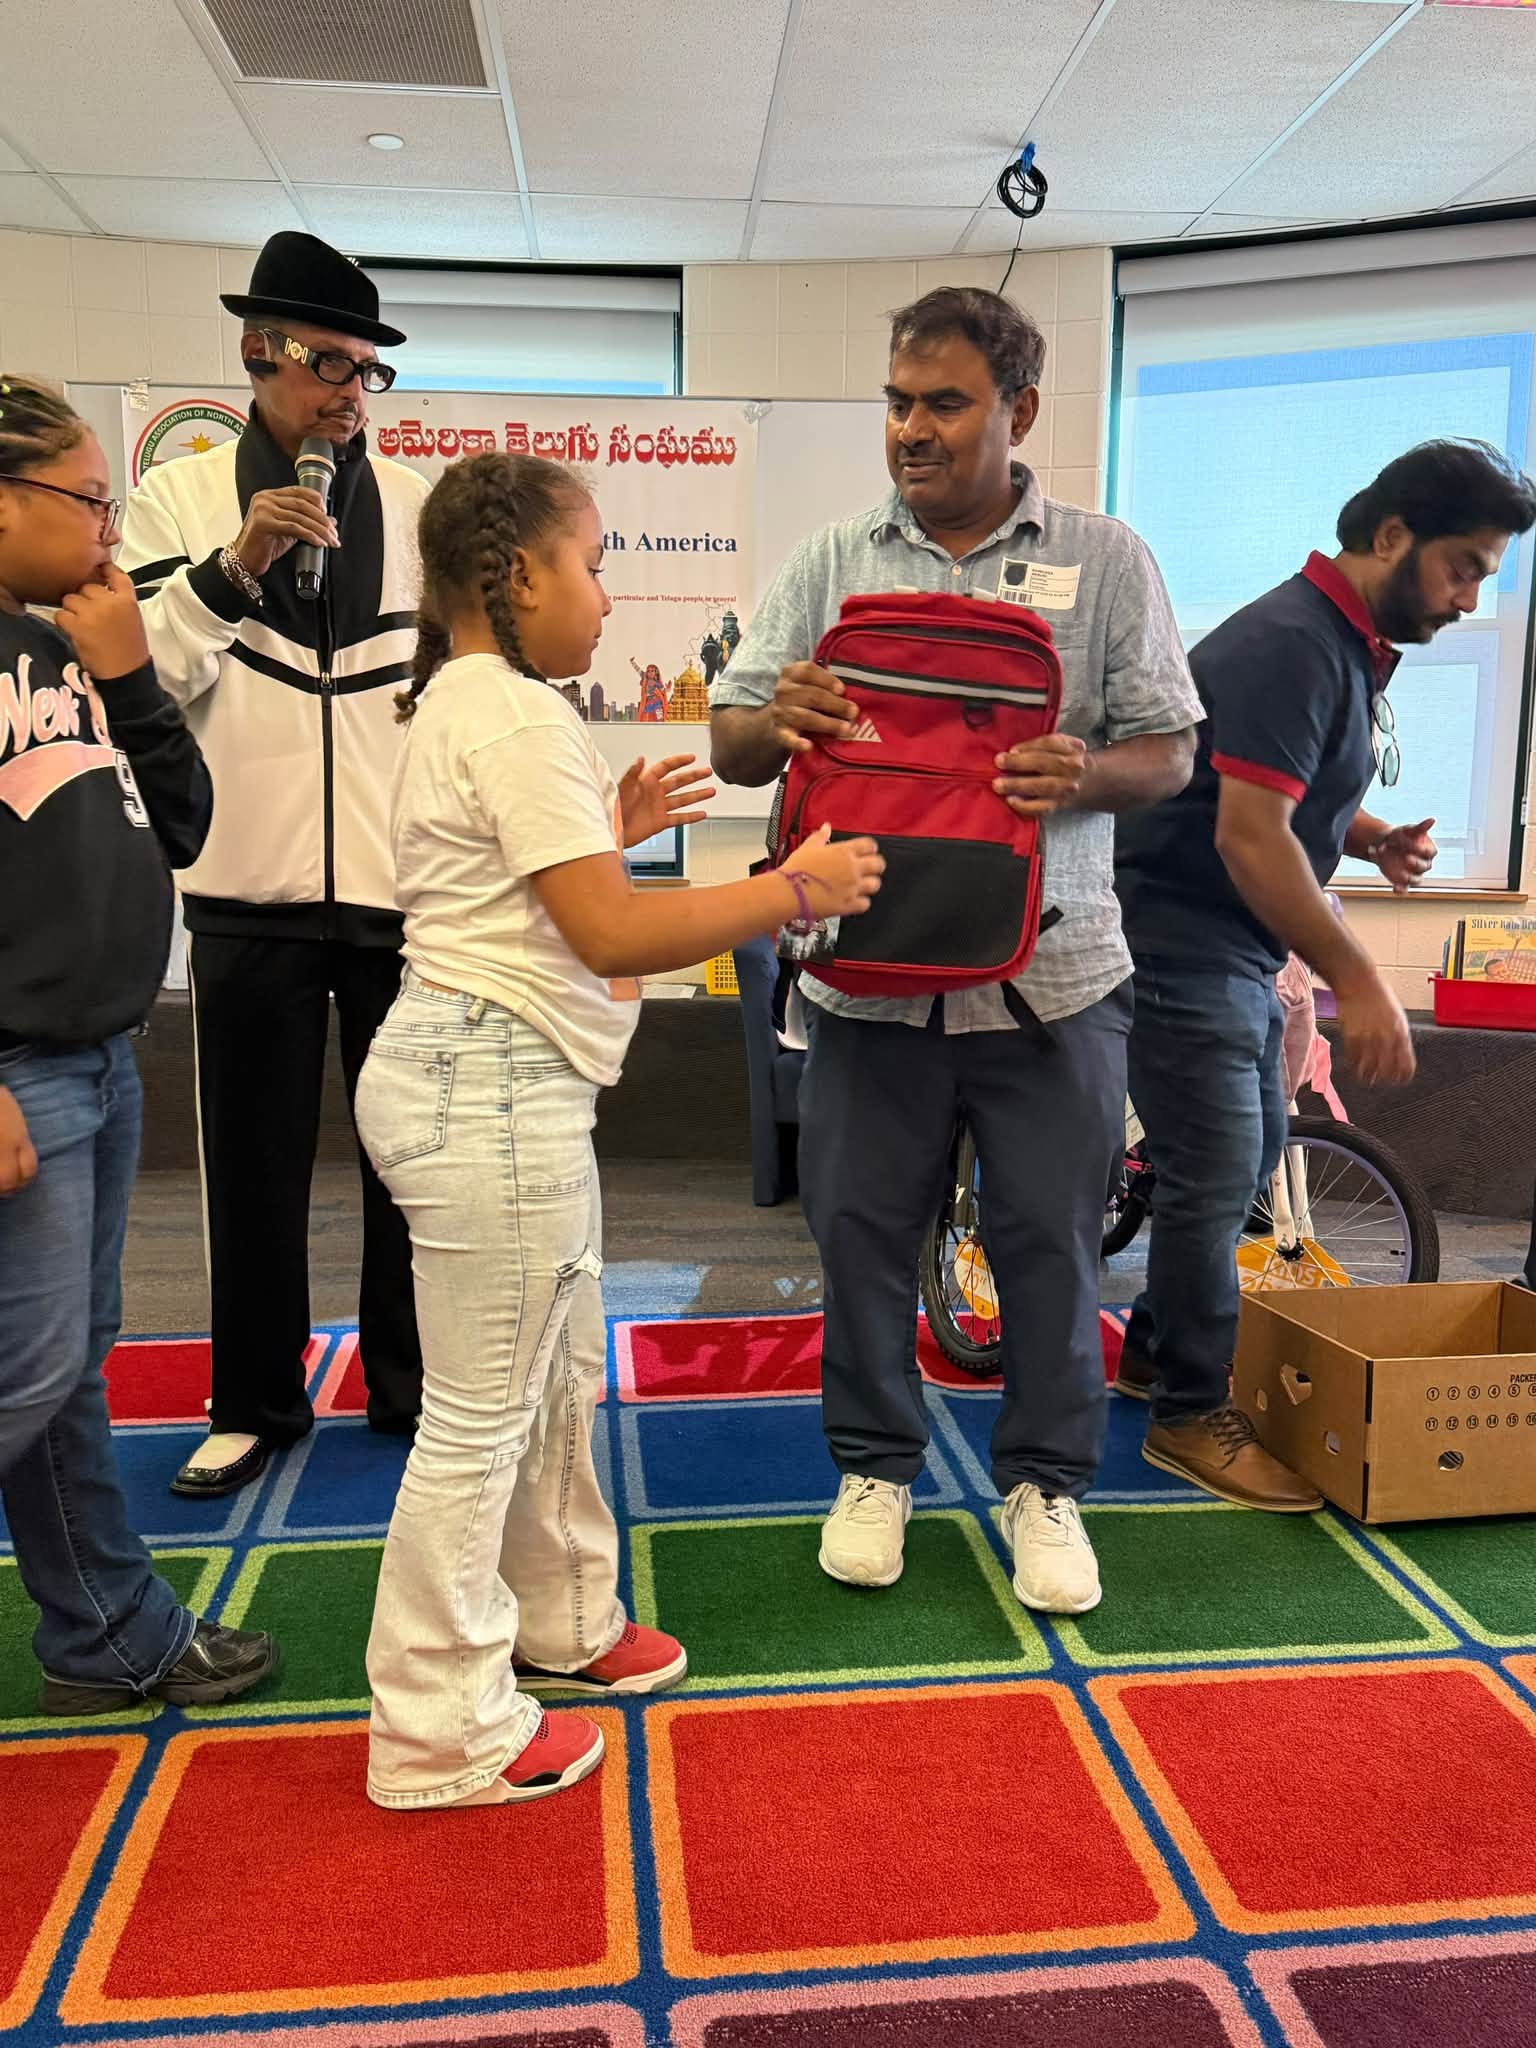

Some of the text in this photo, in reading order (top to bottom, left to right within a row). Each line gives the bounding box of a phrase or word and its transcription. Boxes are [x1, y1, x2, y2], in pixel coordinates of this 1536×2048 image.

[143, 440, 156, 470] TELUGU
[153, 410, 193, 442] ASSOCIATION
[194, 408, 205, 417] OF
[206, 410, 234, 427] NORTH
[377, 420, 496, 458] అమెరికా
[603, 531, 738, 552] th America
[1471, 919, 1499, 929] Silver
[1509, 1373, 1536, 1383] PACKE
